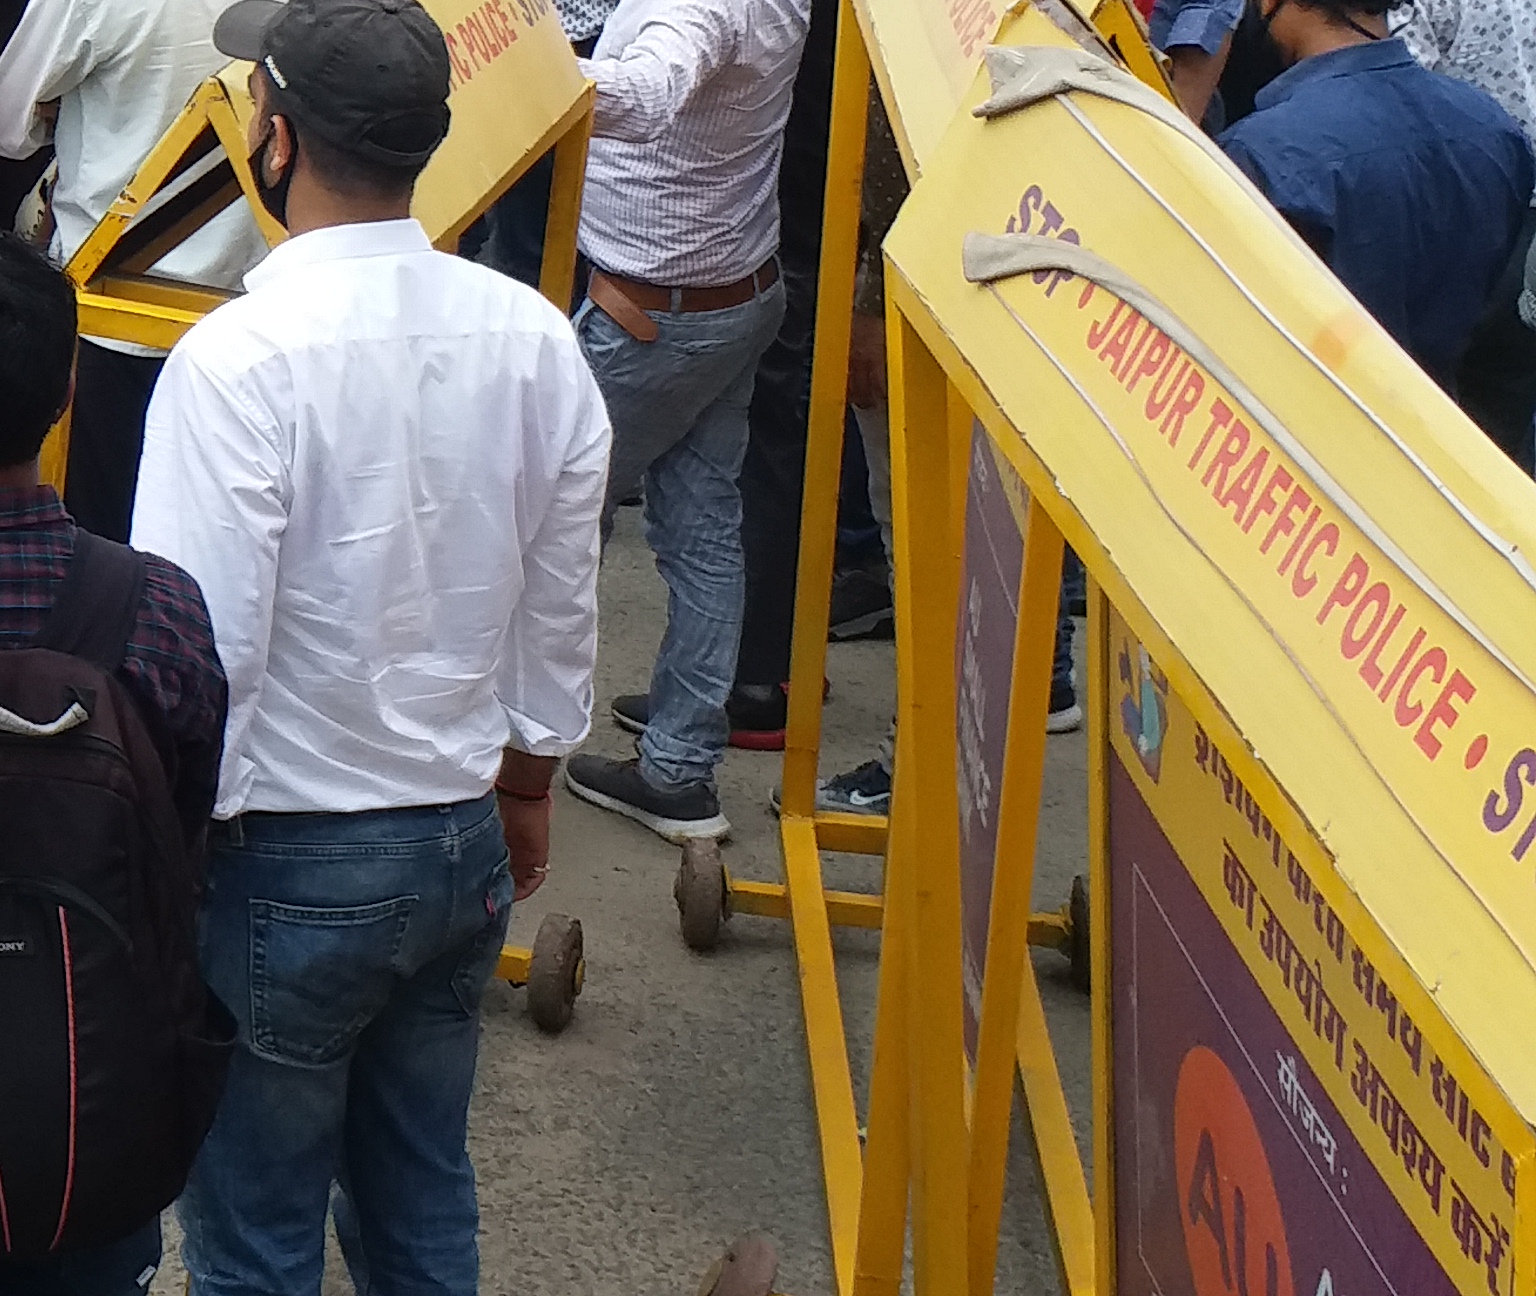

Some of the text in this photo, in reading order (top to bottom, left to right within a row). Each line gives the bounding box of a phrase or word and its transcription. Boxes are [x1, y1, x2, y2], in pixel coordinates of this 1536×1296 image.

[1085, 300, 1206, 450] JAIPUR
[1187, 397, 1341, 599] TRAFFIC
[1316, 552, 1478, 762] POLICE
[1224, 837, 1256, 931] का
[1259, 890, 1349, 1073] उपयोग
[1350, 1037, 1447, 1217] अवश्य
